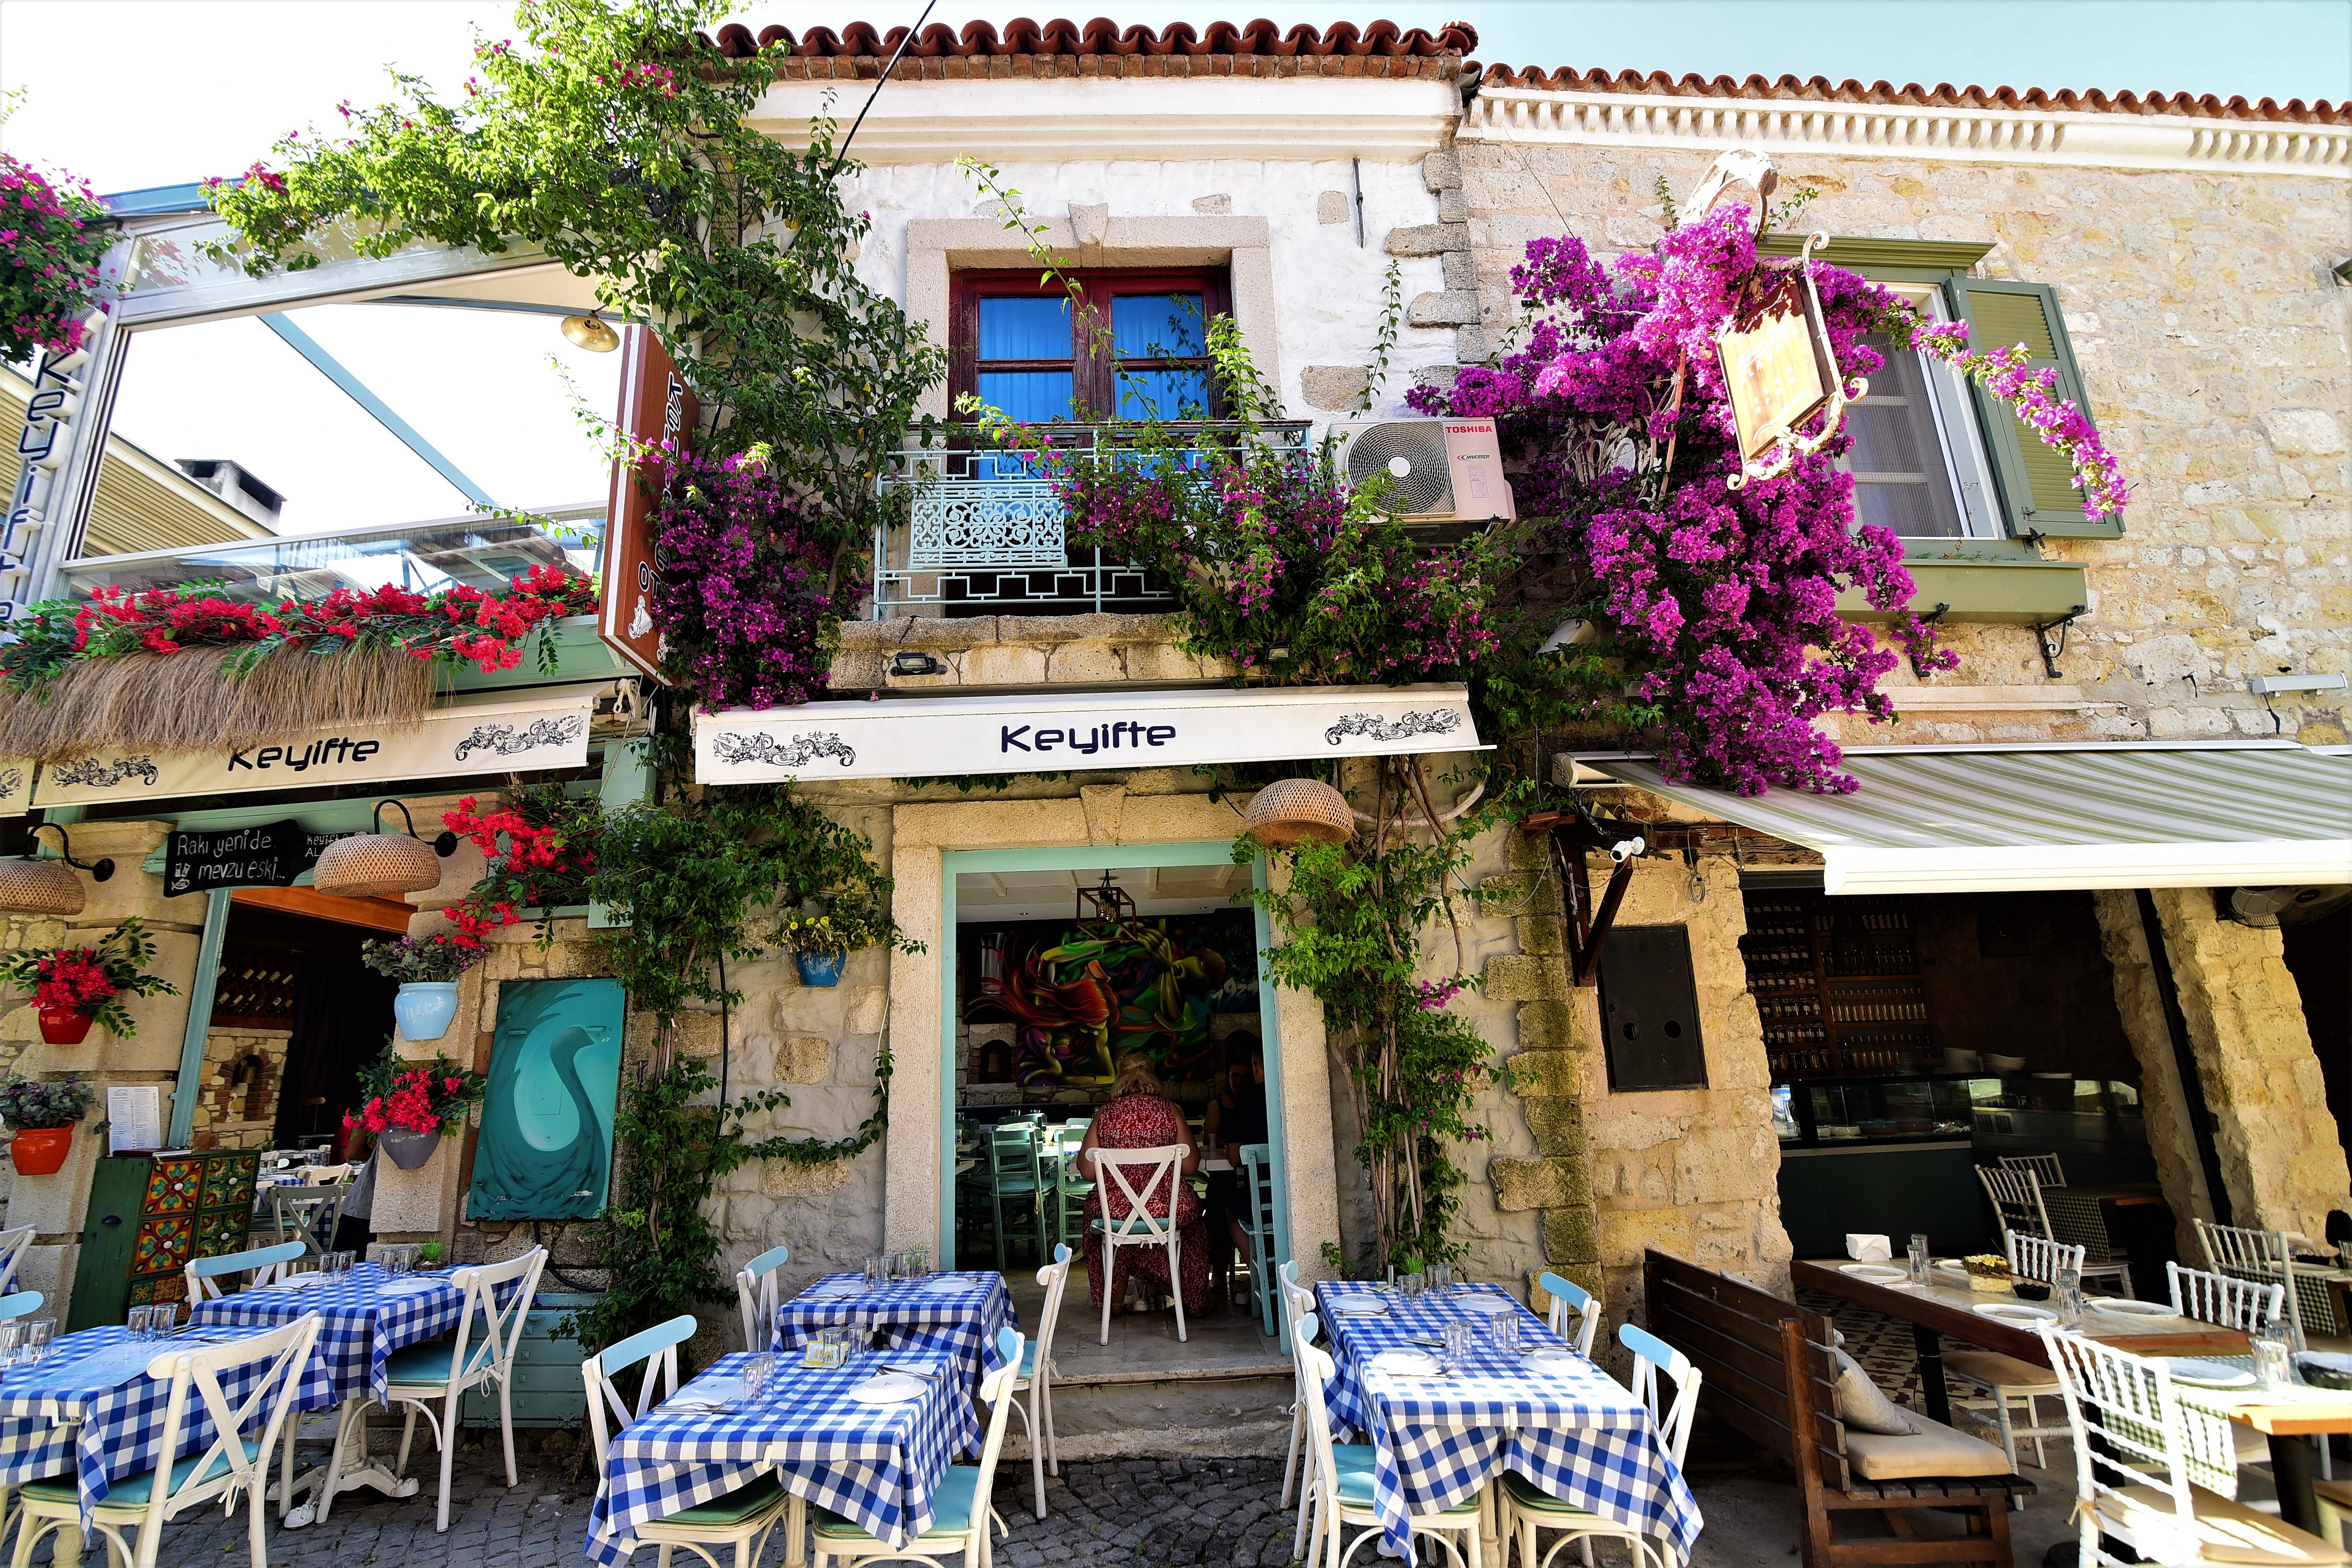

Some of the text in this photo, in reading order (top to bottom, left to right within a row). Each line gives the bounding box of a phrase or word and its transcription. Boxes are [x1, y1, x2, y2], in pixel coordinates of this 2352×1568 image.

[1001, 721, 1176, 754] Keyifte
[228, 737, 380, 771] Keyifte
[177, 835, 208, 855] Rakı
[198, 862, 243, 879] mevzu
